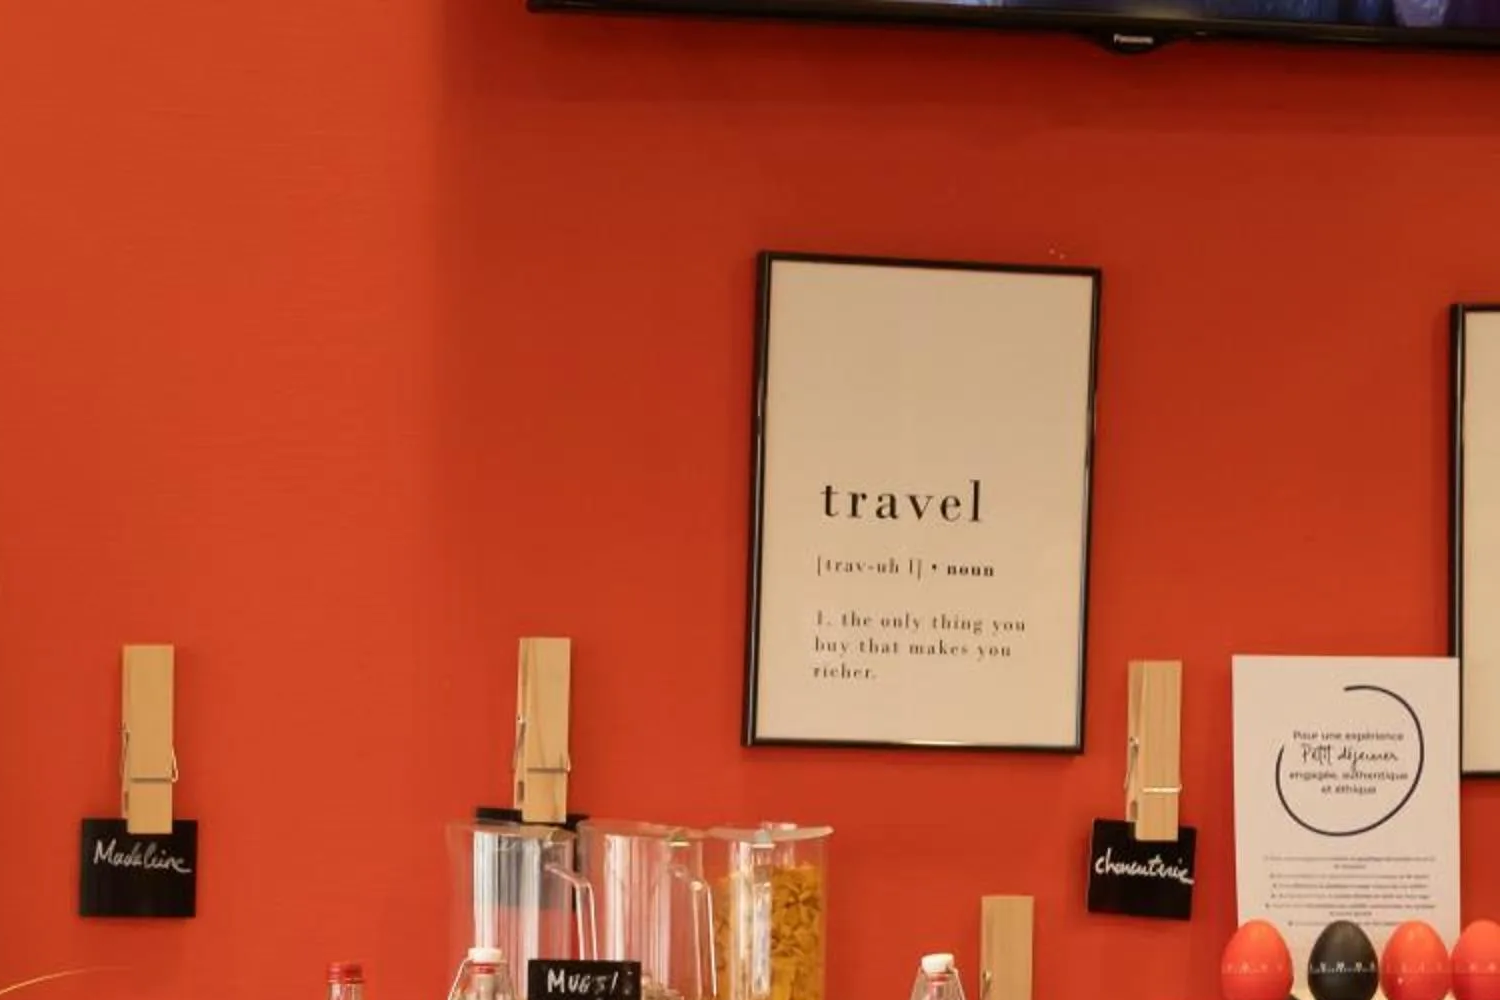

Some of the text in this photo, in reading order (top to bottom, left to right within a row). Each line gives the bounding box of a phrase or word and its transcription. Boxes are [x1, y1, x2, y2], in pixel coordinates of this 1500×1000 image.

[820, 479, 982, 523] travel
[947, 564, 994, 577] noun
[842, 611, 872, 628] the
[880, 612, 921, 632] only
[932, 614, 983, 635] thing
[992, 620, 1026, 637] you
[815, 637, 1012, 662] buy that makes you
[813, 663, 878, 680] richer.
